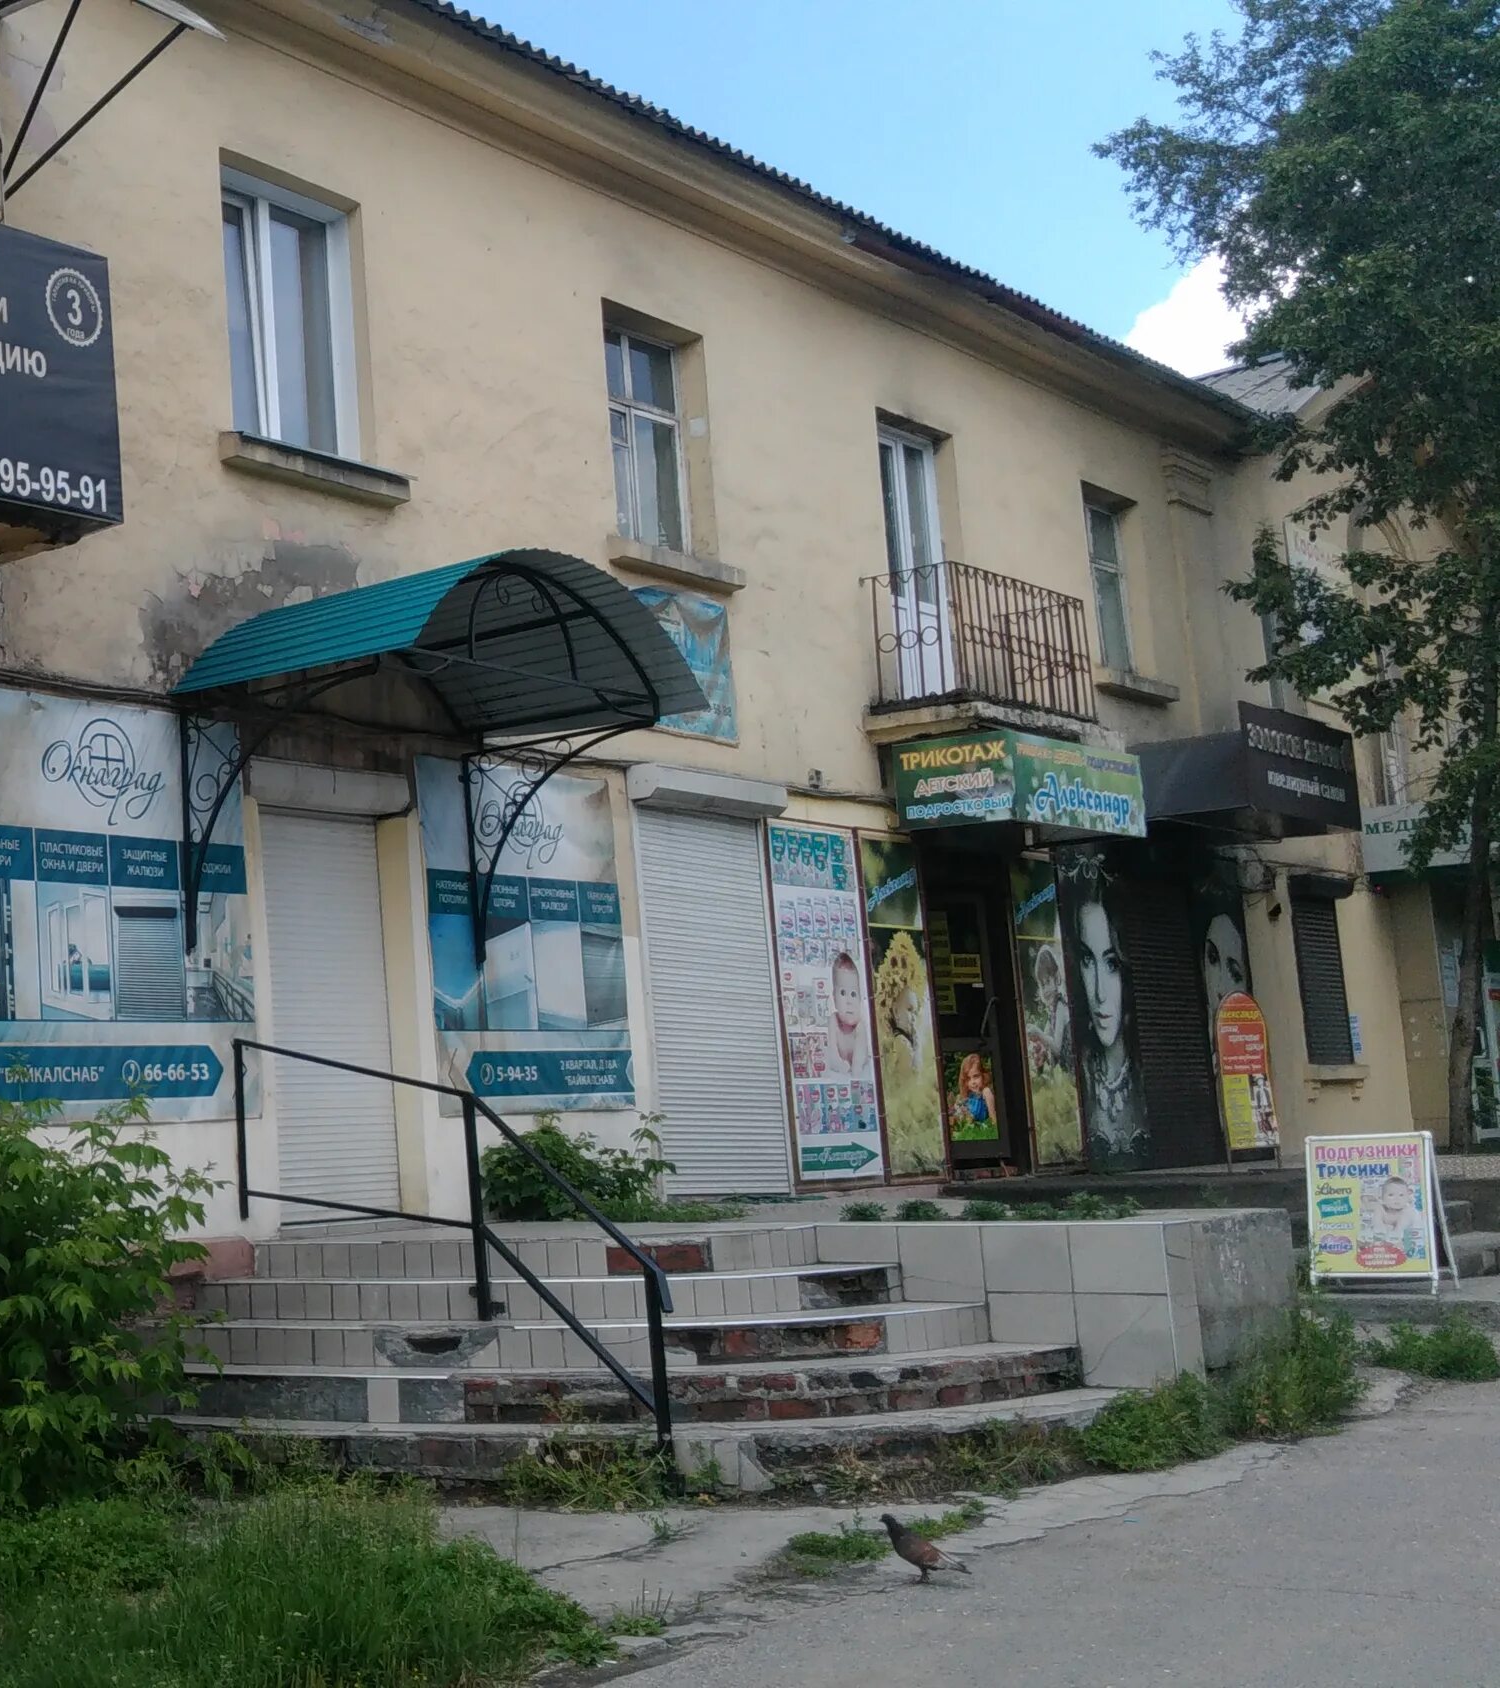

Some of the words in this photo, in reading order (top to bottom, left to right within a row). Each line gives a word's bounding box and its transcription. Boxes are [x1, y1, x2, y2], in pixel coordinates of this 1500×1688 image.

[67, 289, 82, 325] 3
[66, 327, 85, 340] года
[0, 458, 107, 512] 95-95-91
[900, 740, 1006, 771] ТРИКОТАЖ
[41, 739, 165, 826] Окнаград
[914, 768, 994, 797] ДЕТСКИЙ
[906, 793, 1013, 820] ПОДРОСТКОВЫЙ
[1034, 772, 1131, 828] Александр
[40, 842, 103, 857] ПЛАСТИКОВЫЕ
[121, 848, 167, 863] ЗАЩИТНЫЕ
[41, 858, 66, 871] ОКНА
[68, 860, 75, 871] И
[76, 860, 104, 874] ДВЕРИ
[127, 864, 164, 878] ЖАЛЮЗИ
[201, 862, 231, 875] ОДЖИИ
[144, 1063, 209, 1081] 66-66-53
[497, 1066, 538, 1082] 5-94-35
